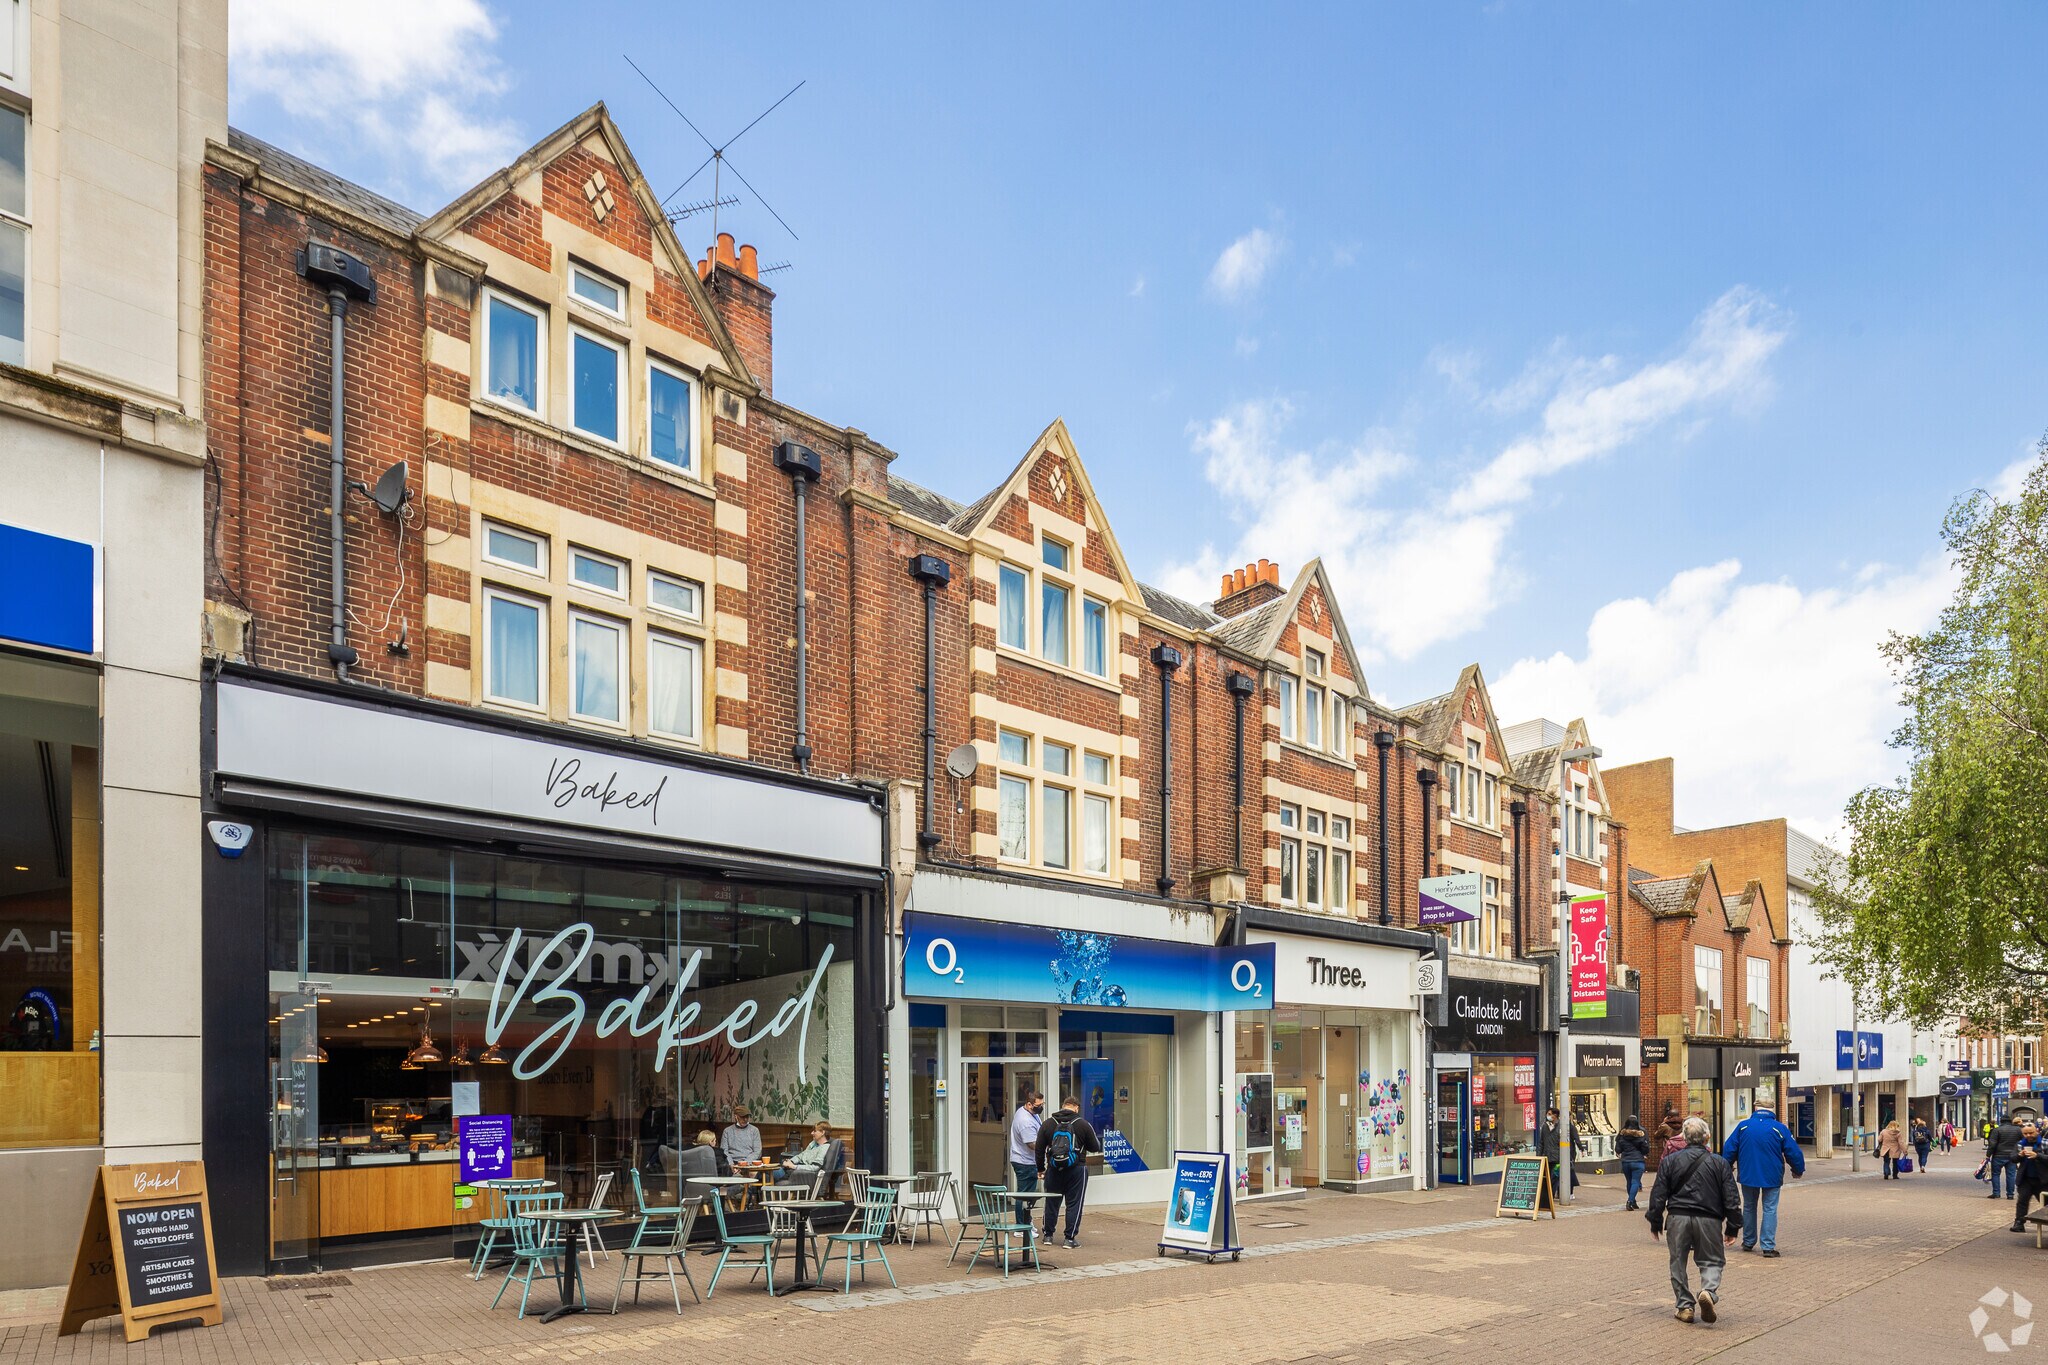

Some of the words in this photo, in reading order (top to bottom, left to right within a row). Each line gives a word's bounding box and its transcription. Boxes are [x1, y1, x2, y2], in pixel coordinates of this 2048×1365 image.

[546, 757, 668, 826] Baked
[1444, 890, 1477, 898] Commercial
[1580, 907, 1598, 915] Keep
[1580, 915, 1597, 923] Safe
[926, 938, 965, 984] O2
[1231, 960, 1262, 998] O2
[1578, 980, 1600, 988] Social
[1573, 990, 1605, 998] Distance
[485, 923, 835, 1085] Baked
[1455, 995, 1499, 1019] Charlotte
[1502, 999, 1522, 1020] Reid
[1476, 1024, 1503, 1035] LONDON
[1583, 1054, 1605, 1067] Warren
[1605, 1054, 1623, 1067] James
[1514, 1072, 1535, 1086] SALE
[1103, 1129, 1121, 1138] Here
[1103, 1139, 1127, 1148] comes
[1103, 1147, 1134, 1158] brighter
[1180, 1169, 1194, 1178] Save
[134, 1170, 181, 1193] Baked
[126, 1211, 158, 1225] NOW
[161, 1208, 195, 1222] OPEN
[136, 1226, 168, 1236] SERVING
[169, 1223, 189, 1232] HAND
[133, 1236, 167, 1247] ROASTED
[168, 1232, 195, 1242] COFFEE
[140, 1262, 172, 1273] ARTISAN
[172, 1258, 195, 1268] CAKES
[145, 1273, 187, 1286] SMOOTHIES
[149, 1282, 194, 1296] MILKSHAKES
